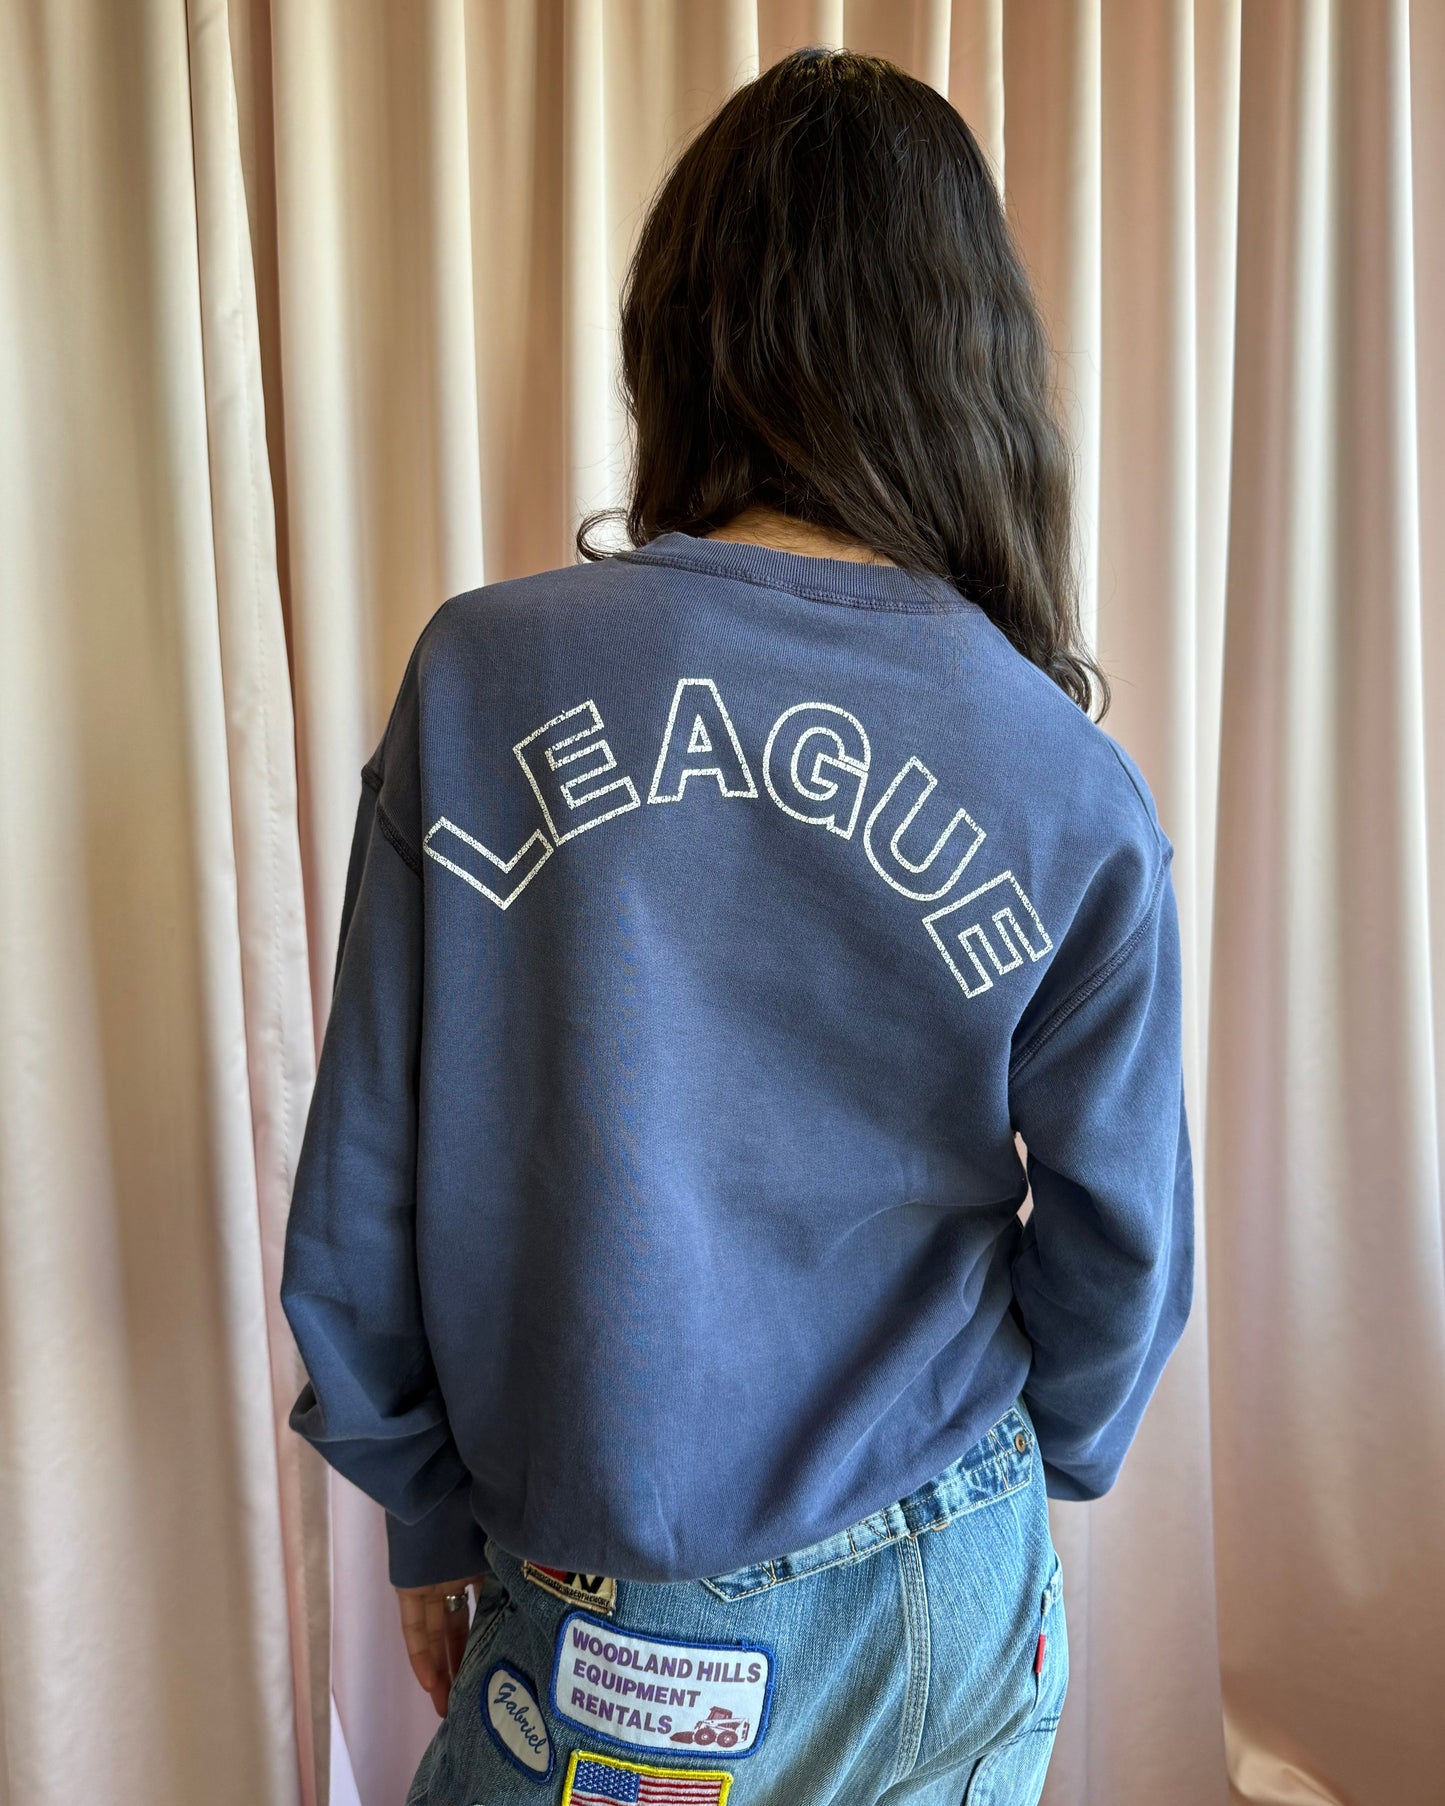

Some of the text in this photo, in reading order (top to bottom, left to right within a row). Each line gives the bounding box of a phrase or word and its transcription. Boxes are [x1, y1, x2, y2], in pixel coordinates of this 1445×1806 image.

[423, 678, 1054, 998] LEAGUE
[572, 1627, 762, 1683] WOODLAND HILLS
[572, 1658, 701, 1708] EQUIPMENT
[493, 1682, 547, 1754] Gabriel
[571, 1687, 673, 1735] RENTALS
